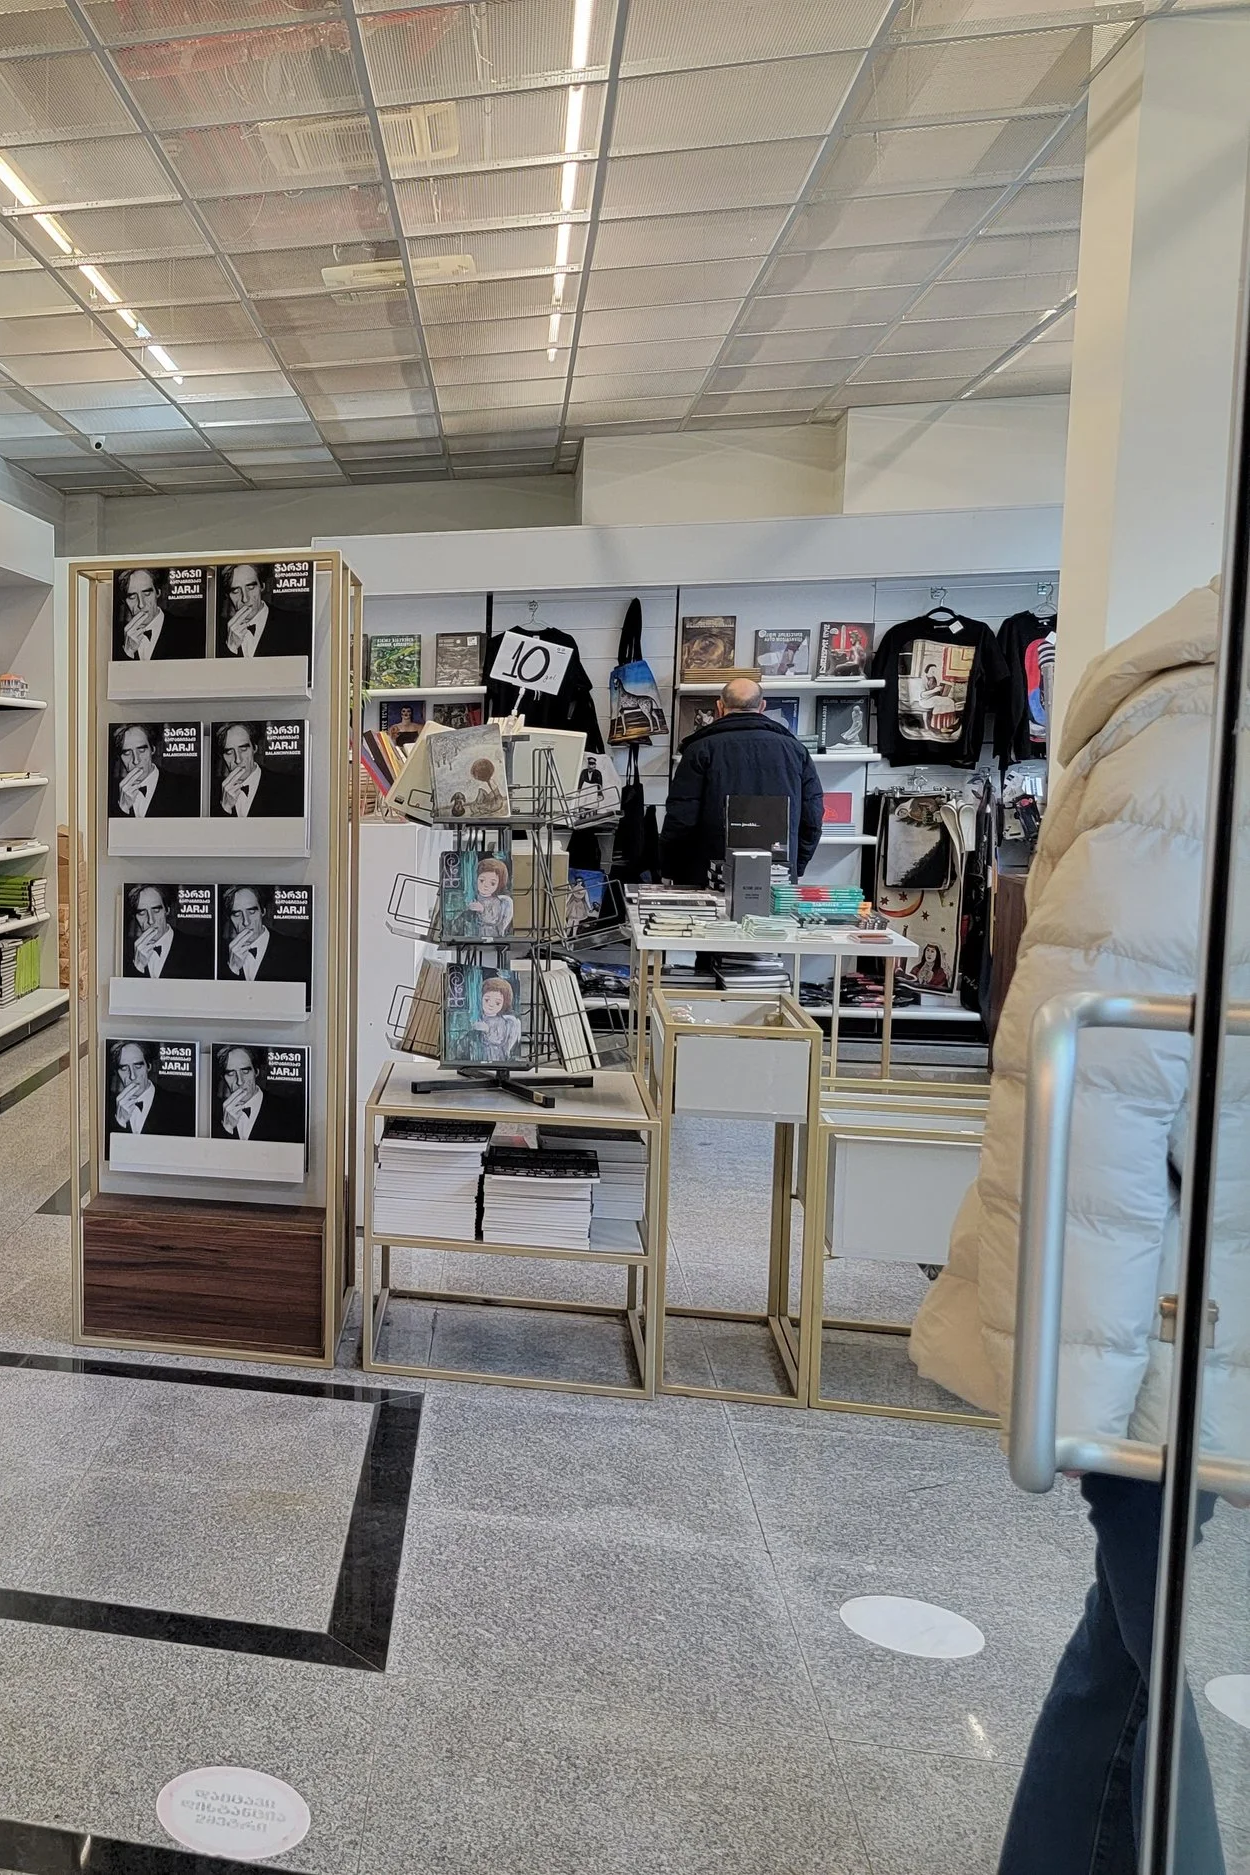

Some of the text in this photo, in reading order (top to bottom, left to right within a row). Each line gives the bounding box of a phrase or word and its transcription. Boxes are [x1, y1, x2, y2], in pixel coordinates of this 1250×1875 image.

[276, 578, 307, 588] JARJI
[171, 585, 200, 595] JARJI
[501, 640, 551, 683] 10
[166, 743, 195, 752] JARJI
[268, 741, 298, 750] JARJI
[180, 904, 209, 914] JARJI
[276, 905, 306, 915] JARJI
[161, 1062, 190, 1071] JARJI
[270, 1067, 299, 1077] JARJI
